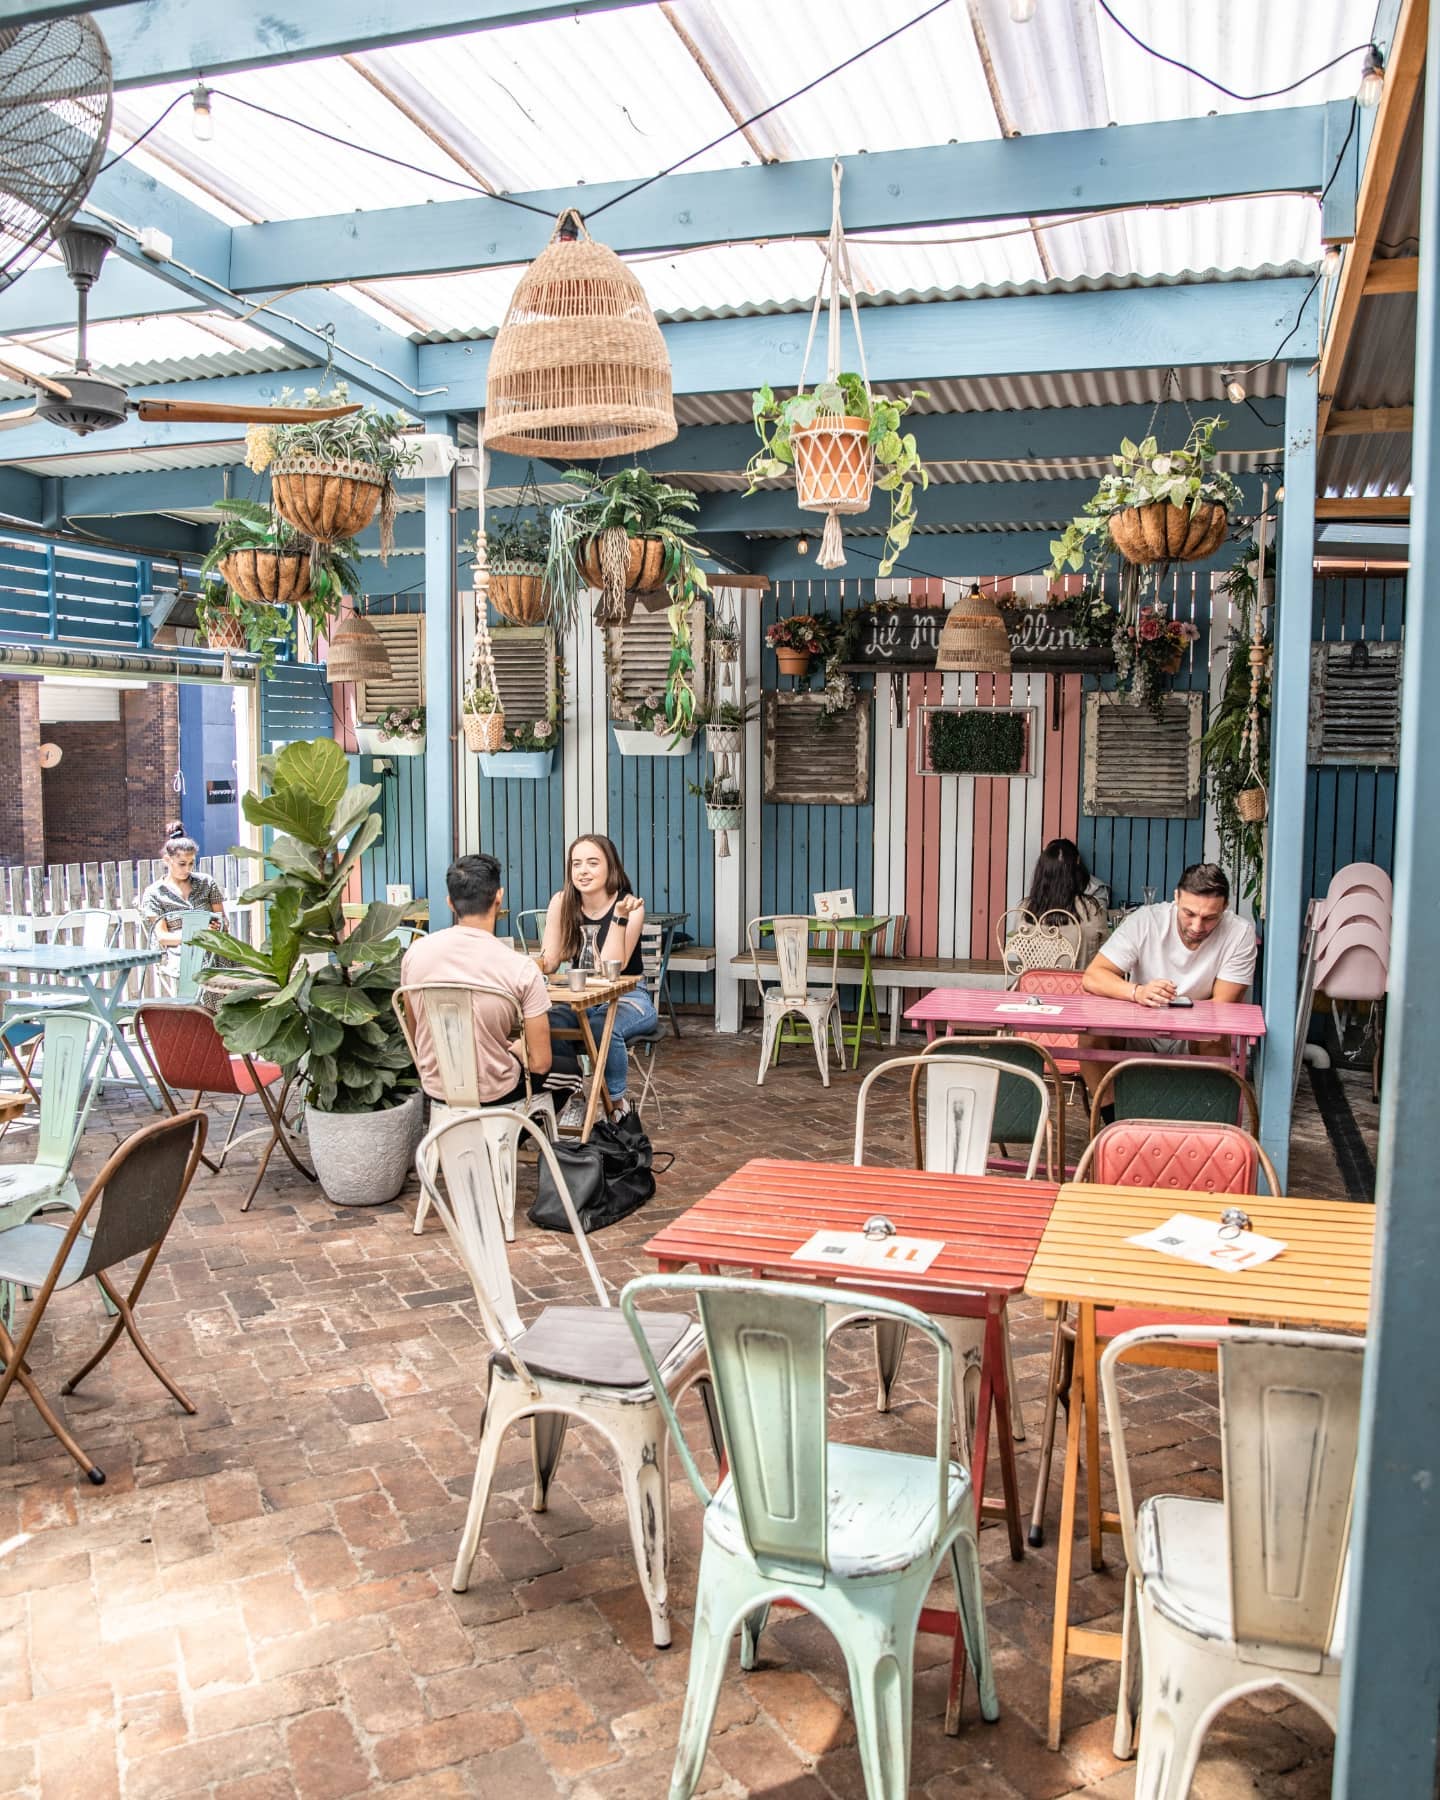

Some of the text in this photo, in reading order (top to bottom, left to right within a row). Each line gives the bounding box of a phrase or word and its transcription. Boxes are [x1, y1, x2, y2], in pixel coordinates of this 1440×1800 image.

[820, 900, 830, 913] 3
[884, 1245, 919, 1262] 11
[1209, 1244, 1257, 1264] 12
